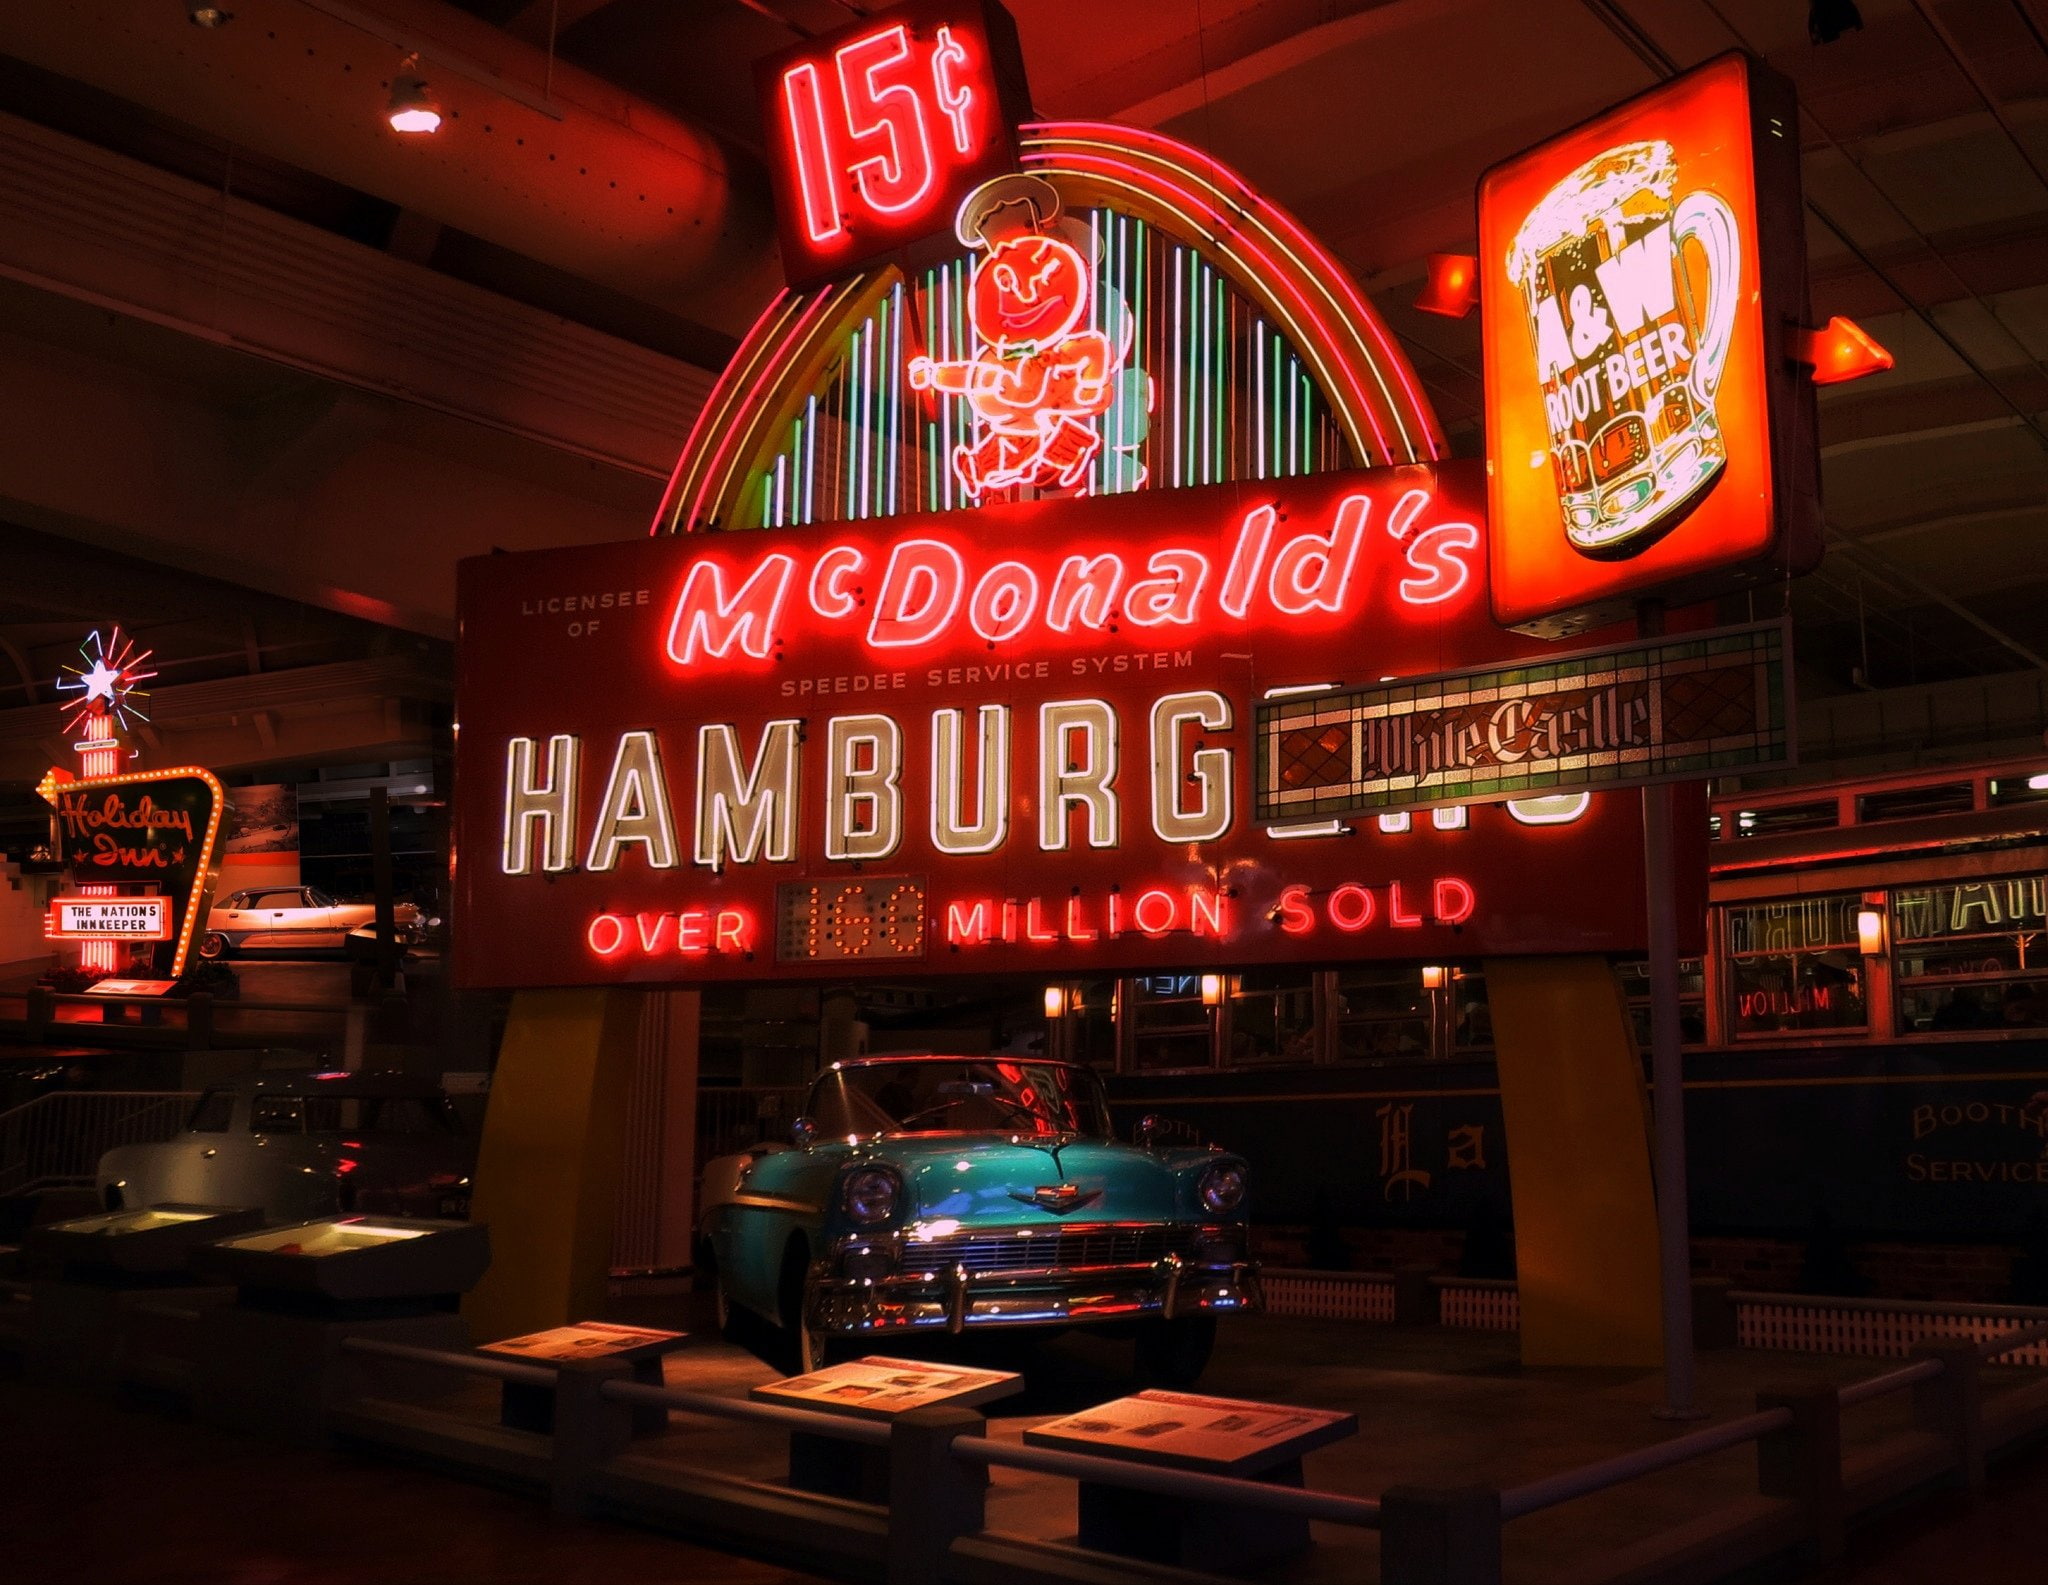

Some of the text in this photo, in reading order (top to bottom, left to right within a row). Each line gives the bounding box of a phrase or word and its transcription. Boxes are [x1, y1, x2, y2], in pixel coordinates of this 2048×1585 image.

[784, 25, 972, 243] 15¢
[1537, 222, 1676, 386] A&W
[1546, 322, 1694, 434] ROOT BEER
[667, 490, 1480, 665] McDonald's
[521, 590, 651, 616] LICENSEE
[567, 620, 601, 637] OF
[780, 650, 1195, 698] SPEEDEE SERVICE SYSTEM
[60, 794, 193, 844] Holiday
[93, 833, 168, 868] Inn
[71, 906, 157, 918] THE NATIONS
[76, 919, 147, 931] INNKEEPER
[587, 877, 1474, 956] OVER 160 MILLION SOLD
